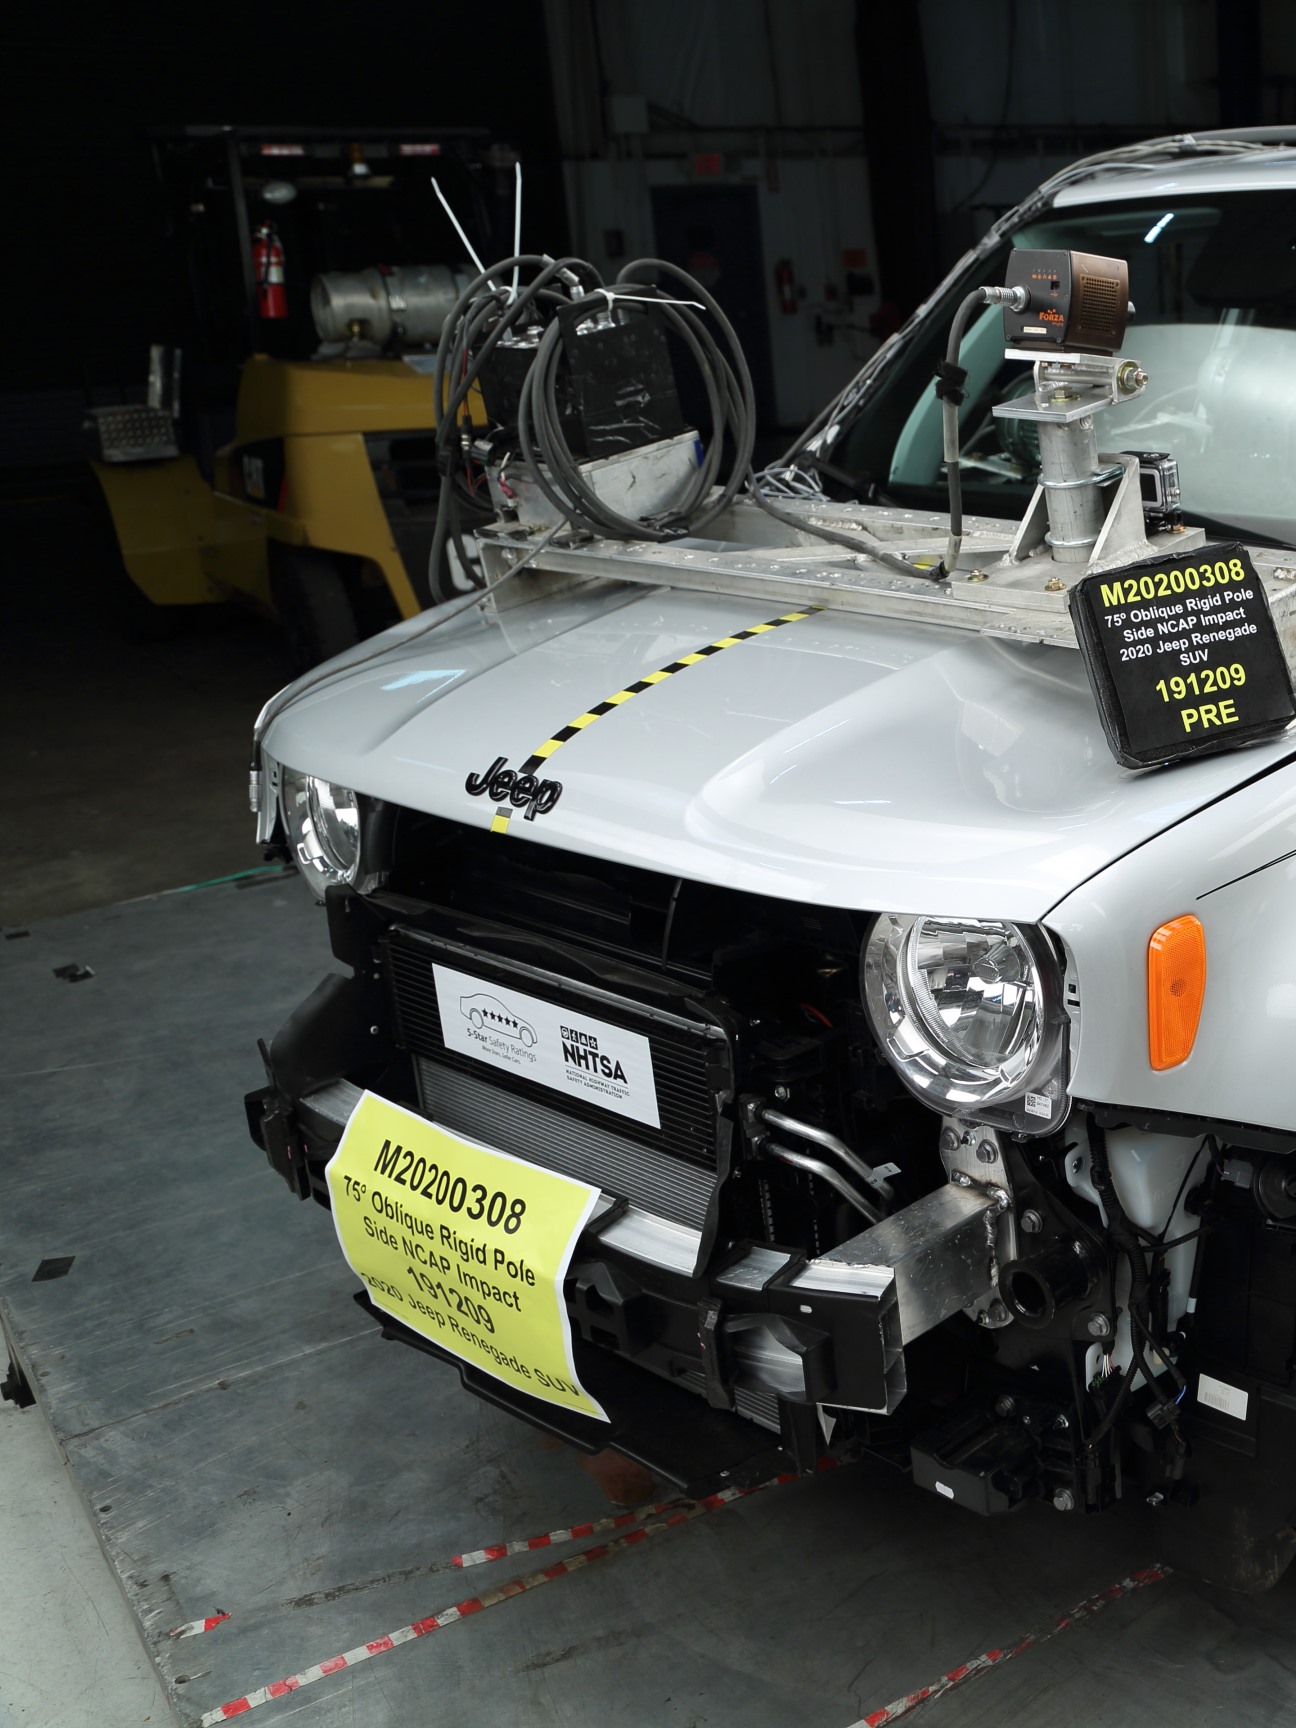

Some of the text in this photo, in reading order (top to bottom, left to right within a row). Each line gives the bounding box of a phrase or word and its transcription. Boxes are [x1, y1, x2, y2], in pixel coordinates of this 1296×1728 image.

[1039, 312, 1064, 322] FORZA
[1100, 559, 1245, 608] M20200308
[1123, 607, 1246, 642] Side NCAP Impact
[1130, 602, 1183, 623] Oblique
[1186, 594, 1222, 612] Rigid
[1223, 588, 1254, 604] Pole
[1120, 622, 1258, 661] 2020 Jeep Renegade
[1179, 648, 1209, 666] SUV
[1156, 663, 1246, 702] 191209
[1181, 699, 1239, 732] PRE
[465, 756, 563, 821] Jeep
[467, 1028, 537, 1062] 5-Star Safety Ratings
[562, 1040, 628, 1084] NHTSA
[565, 1069, 630, 1096] NATIONAL HIGHWAY TRAFFIC
[566, 1075, 623, 1099] SAFETY ADMINISTRATION
[373, 1139, 526, 1234] M20200308
[371, 1191, 435, 1242] Oblique
[440, 1225, 487, 1265] Rigid
[494, 1248, 536, 1287] Pole
[363, 1216, 521, 1312] Side NCAP Impact
[407, 1267, 495, 1333] 191209
[361, 1272, 580, 1396] 2020 Jeep Renegade SUV
